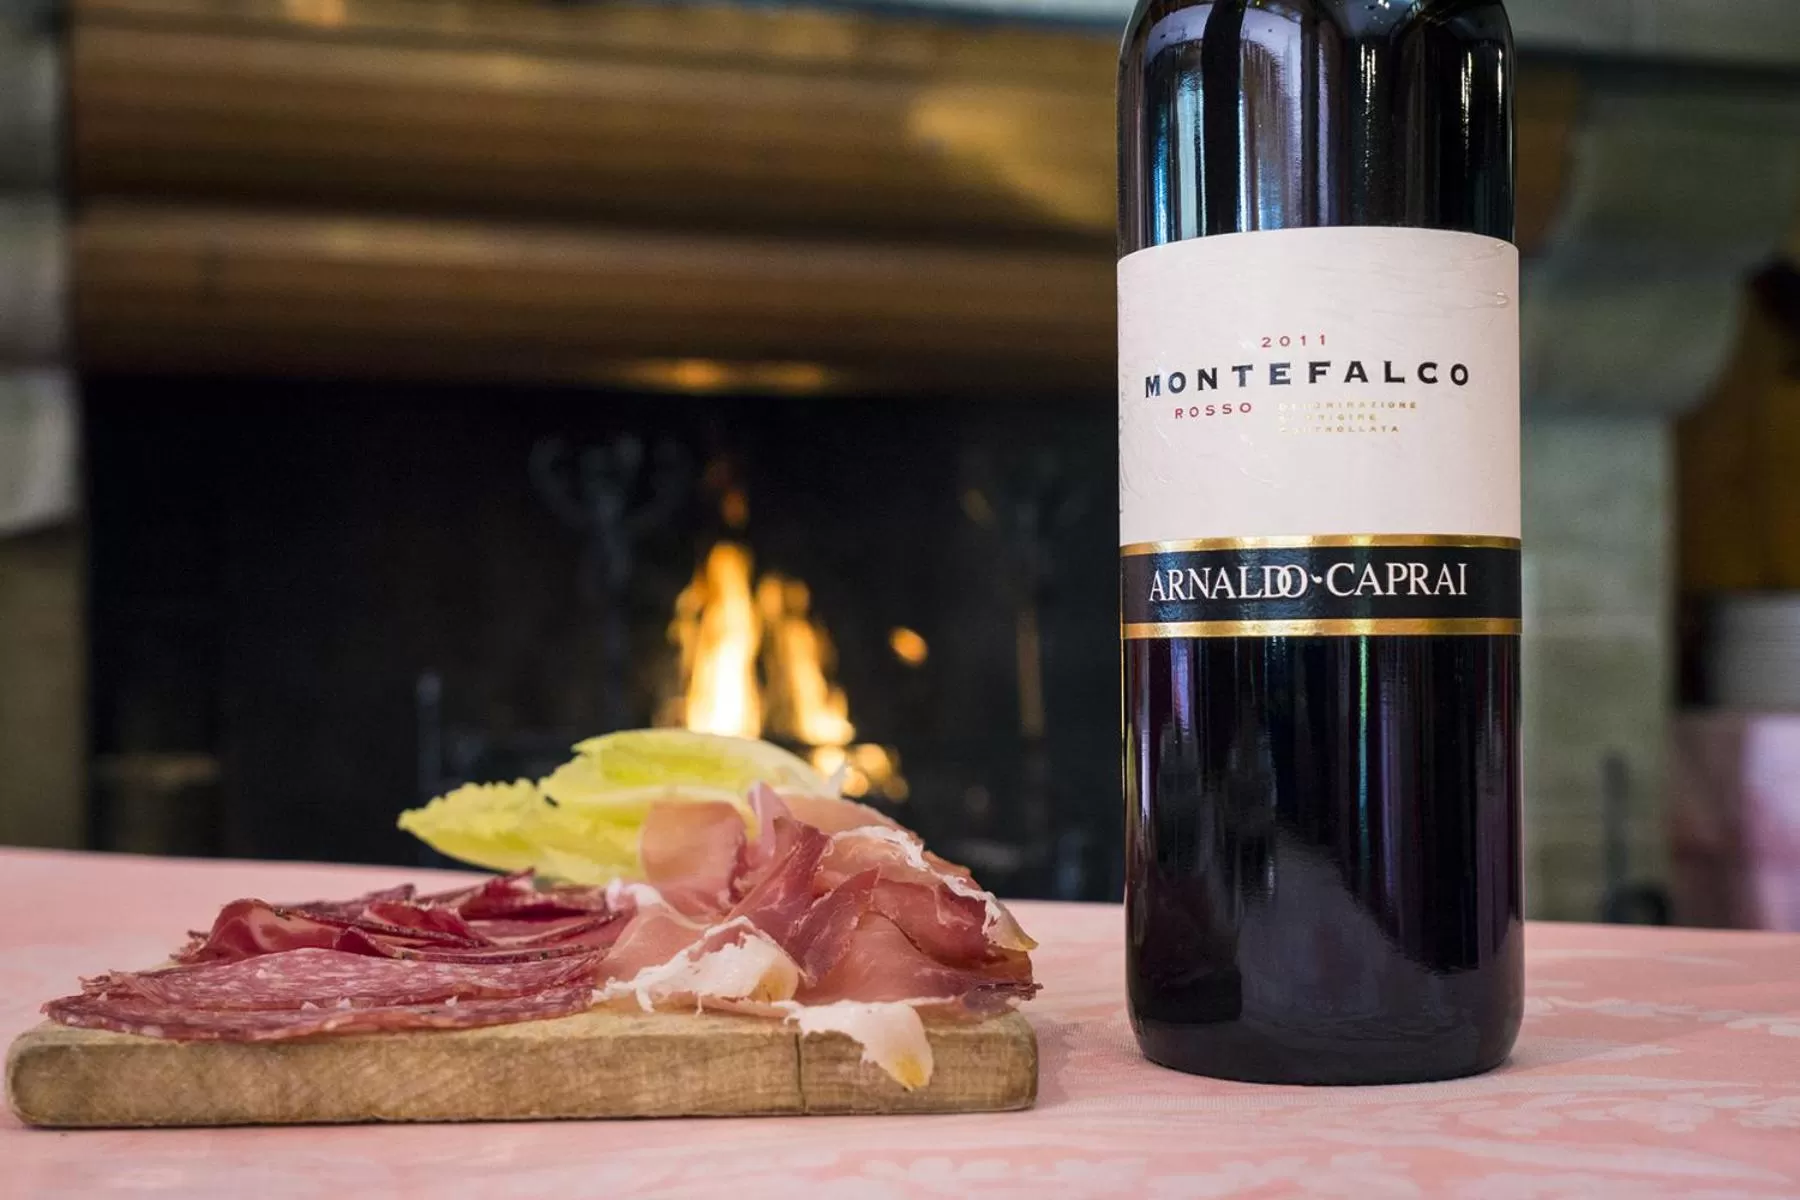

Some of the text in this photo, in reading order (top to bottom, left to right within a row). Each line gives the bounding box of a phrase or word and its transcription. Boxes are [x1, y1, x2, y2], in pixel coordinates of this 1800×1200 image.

[1261, 334, 1326, 348] 2011
[1145, 360, 1469, 398] MONTEFALCO
[1175, 402, 1252, 419] ROSSO
[1278, 401, 1417, 411] DOMINAZIONE
[1279, 424, 1400, 433] CTROLLATA
